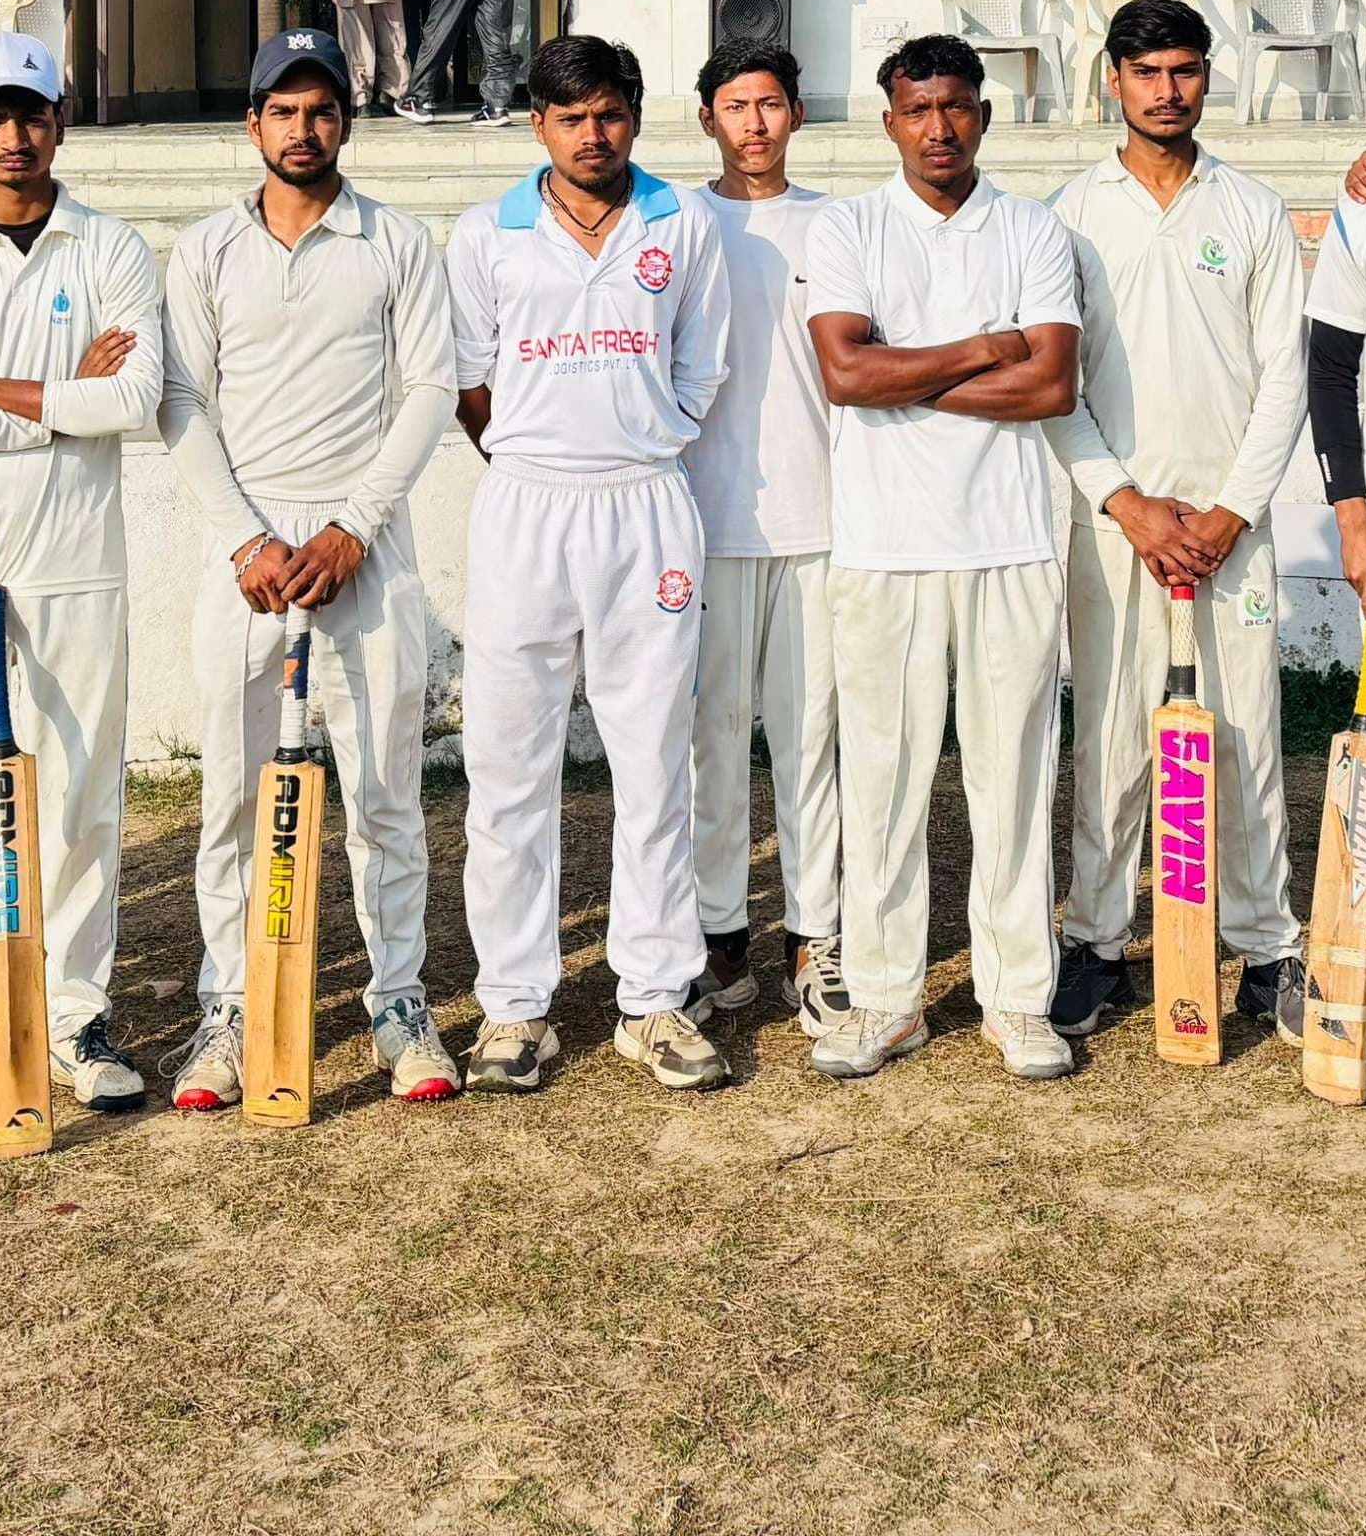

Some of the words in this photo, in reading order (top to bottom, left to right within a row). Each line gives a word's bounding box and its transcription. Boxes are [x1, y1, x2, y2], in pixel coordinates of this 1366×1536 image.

[1196, 263, 1226, 277] BCA
[519, 332, 587, 363] SANTA
[592, 329, 659, 356] FREGH
[550, 360, 601, 376] OGISTICS
[1245, 617, 1272, 627] BCA
[266, 774, 301, 939] ADMIRE
